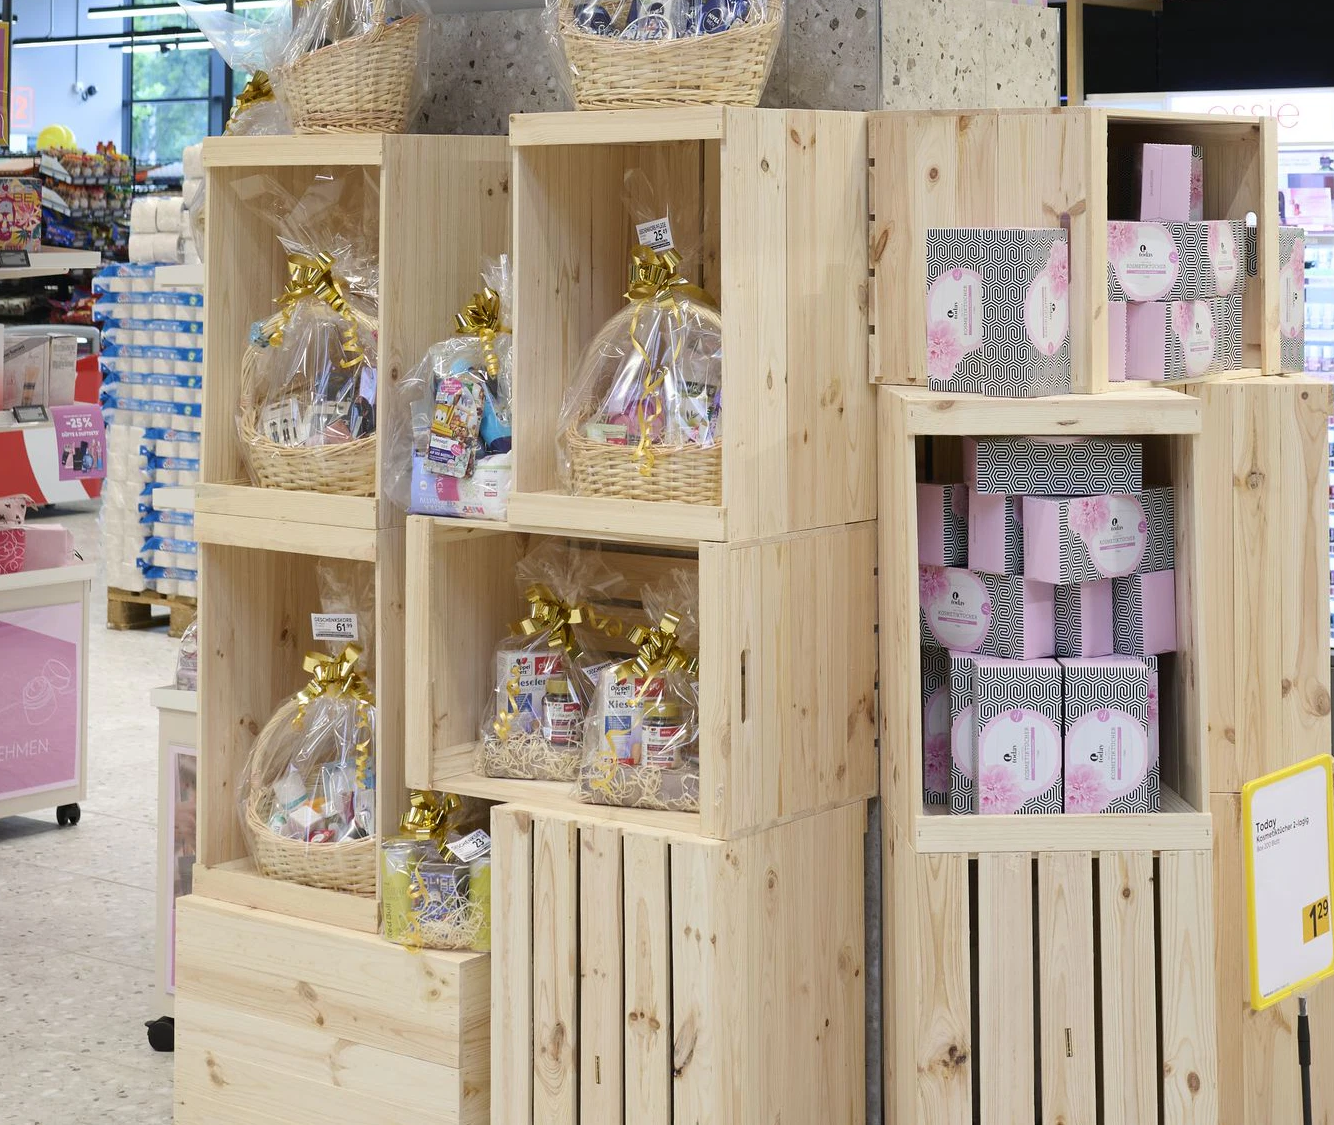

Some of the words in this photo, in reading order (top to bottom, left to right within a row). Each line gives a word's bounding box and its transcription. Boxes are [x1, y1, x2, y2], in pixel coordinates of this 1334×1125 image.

[16, 95, 28, 120] 2
[13, 192, 34, 202] BE
[1256, 818, 1276, 833] Today
